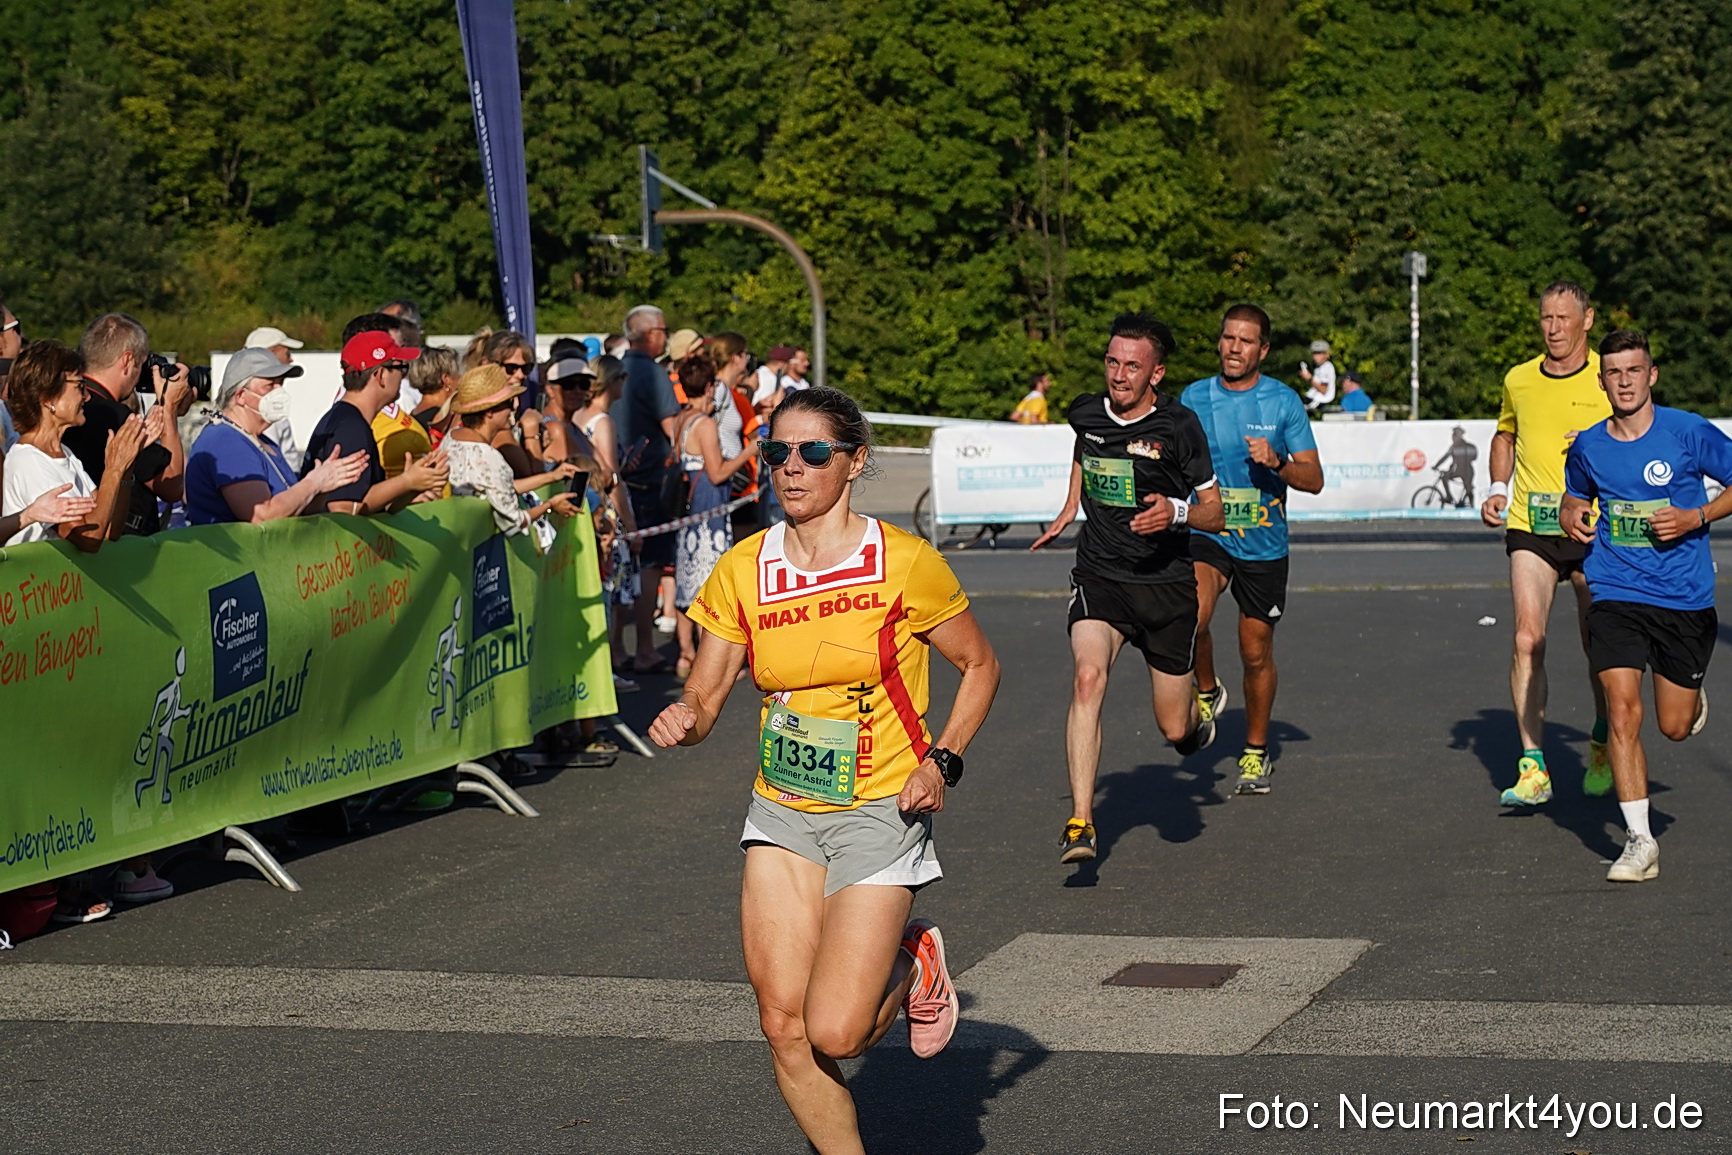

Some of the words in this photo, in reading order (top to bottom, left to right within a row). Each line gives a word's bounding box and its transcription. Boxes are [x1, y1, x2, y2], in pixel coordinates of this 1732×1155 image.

[1092, 474, 1119, 491] 425
[19, 571, 84, 621] Firmen
[368, 561, 413, 625] länger!
[757, 604, 811, 630] MAX
[818, 591, 887, 618] BÖGL
[34, 606, 103, 682] länger!
[222, 611, 260, 641] Fischer
[226, 630, 258, 650] AUTOMOBILE
[182, 648, 313, 765] firmenlauf
[179, 746, 238, 793] neumarkt
[260, 729, 404, 798] www.firmenlauf-oberpfalz.de
[763, 739, 773, 768] RUN
[774, 735, 837, 776] 1334
[837, 755, 851, 793] 2022
[773, 762, 802, 780] Zunner
[803, 773, 832, 788] Astrid
[0, 806, 97, 872] -oberpfalz.de
